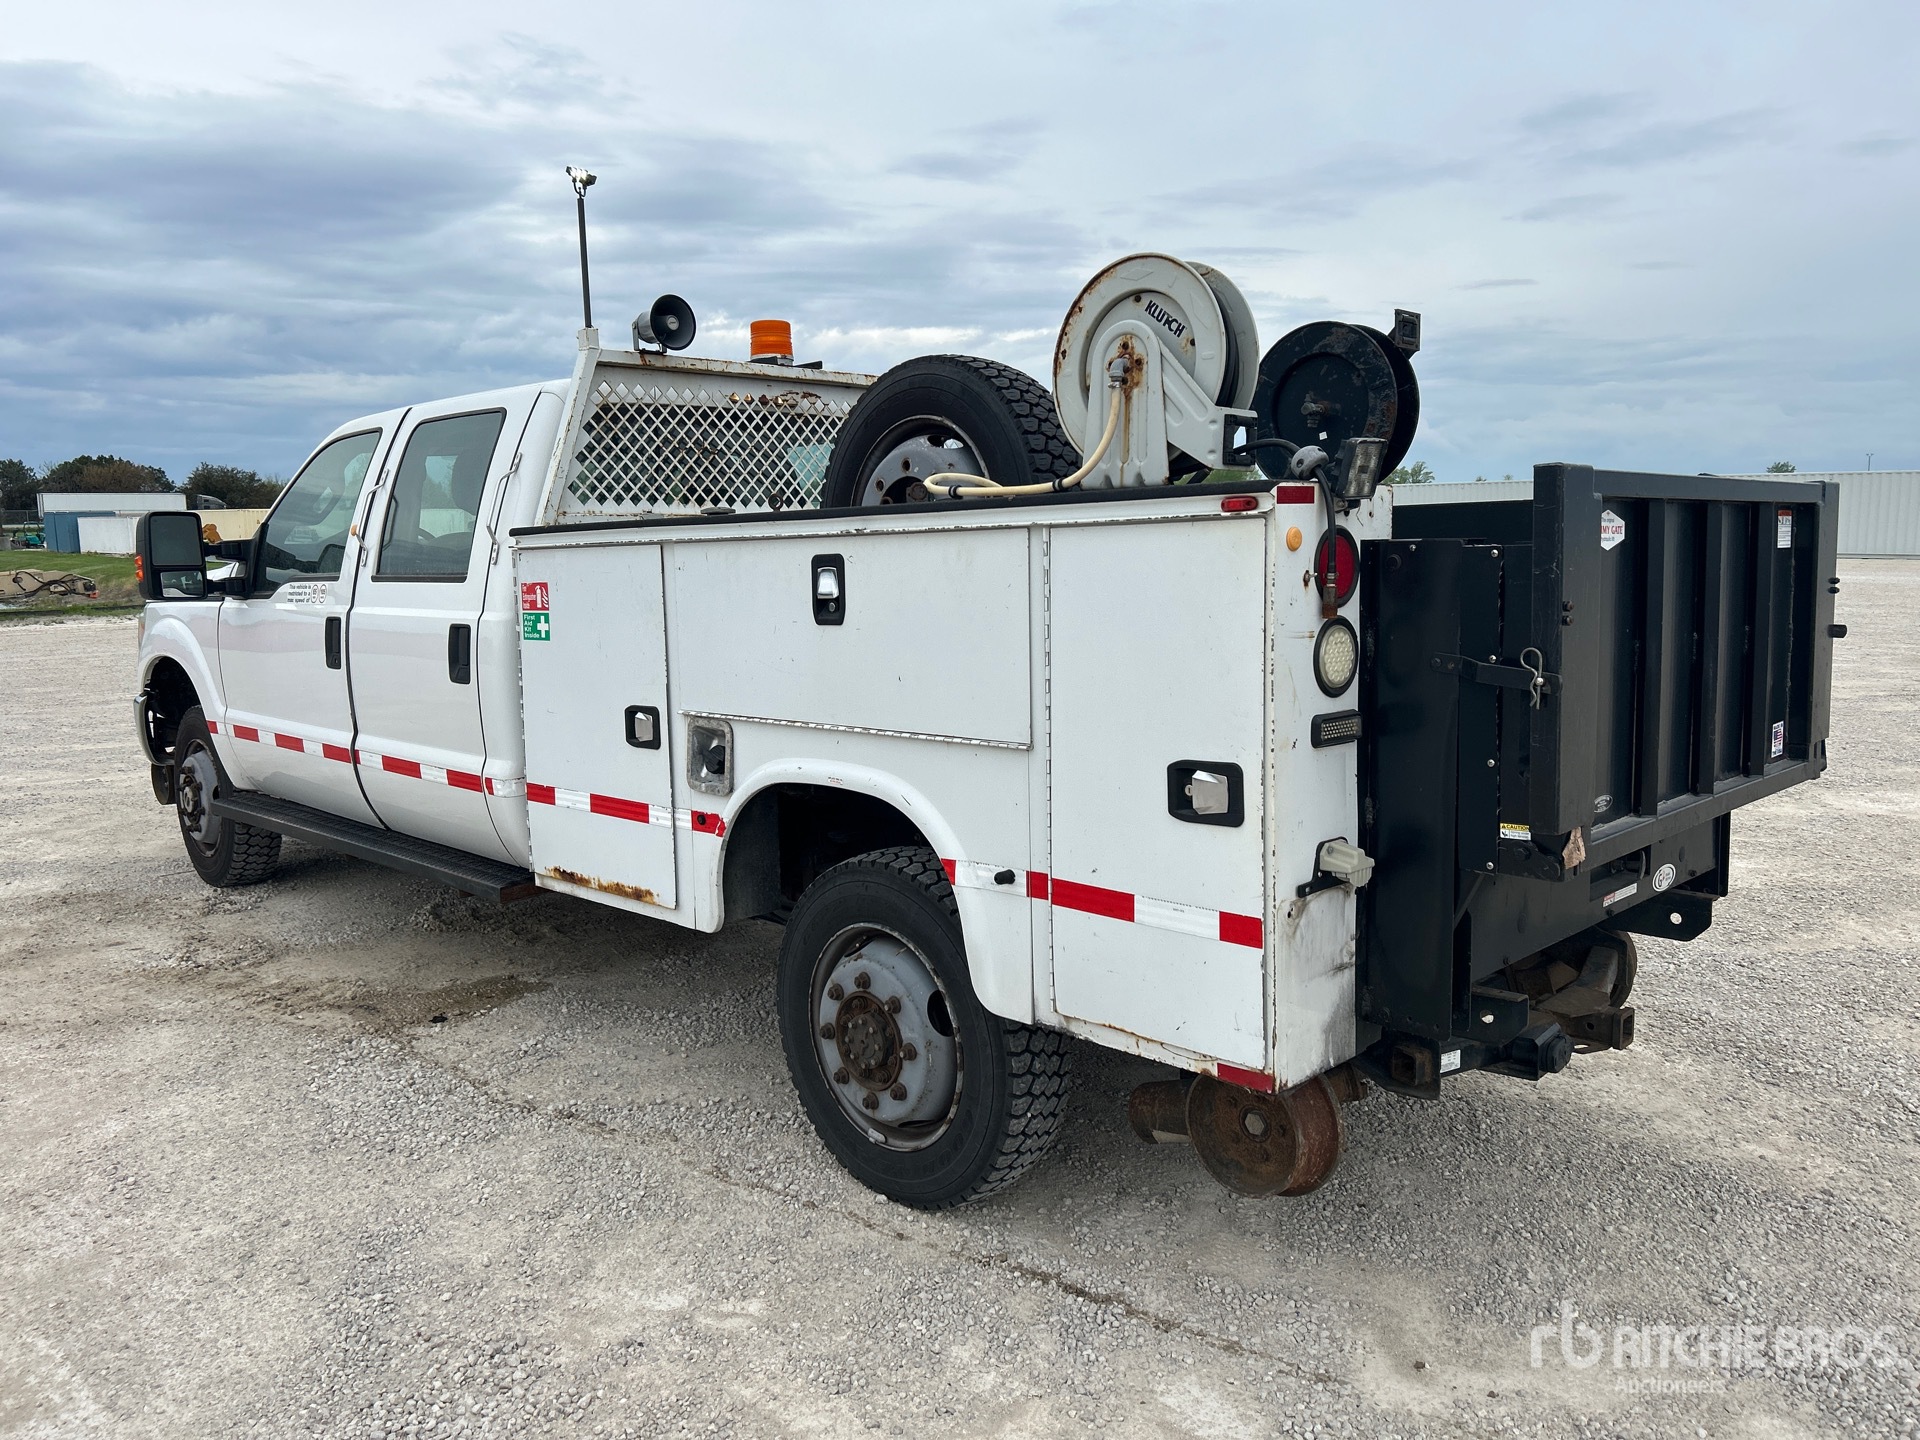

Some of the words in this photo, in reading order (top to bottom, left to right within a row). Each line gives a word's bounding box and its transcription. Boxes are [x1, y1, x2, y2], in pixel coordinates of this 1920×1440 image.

[1145, 299, 1186, 338] KLUTCH
[1611, 525, 1624, 535] GATE
[1506, 824, 1530, 832] CAUTION
